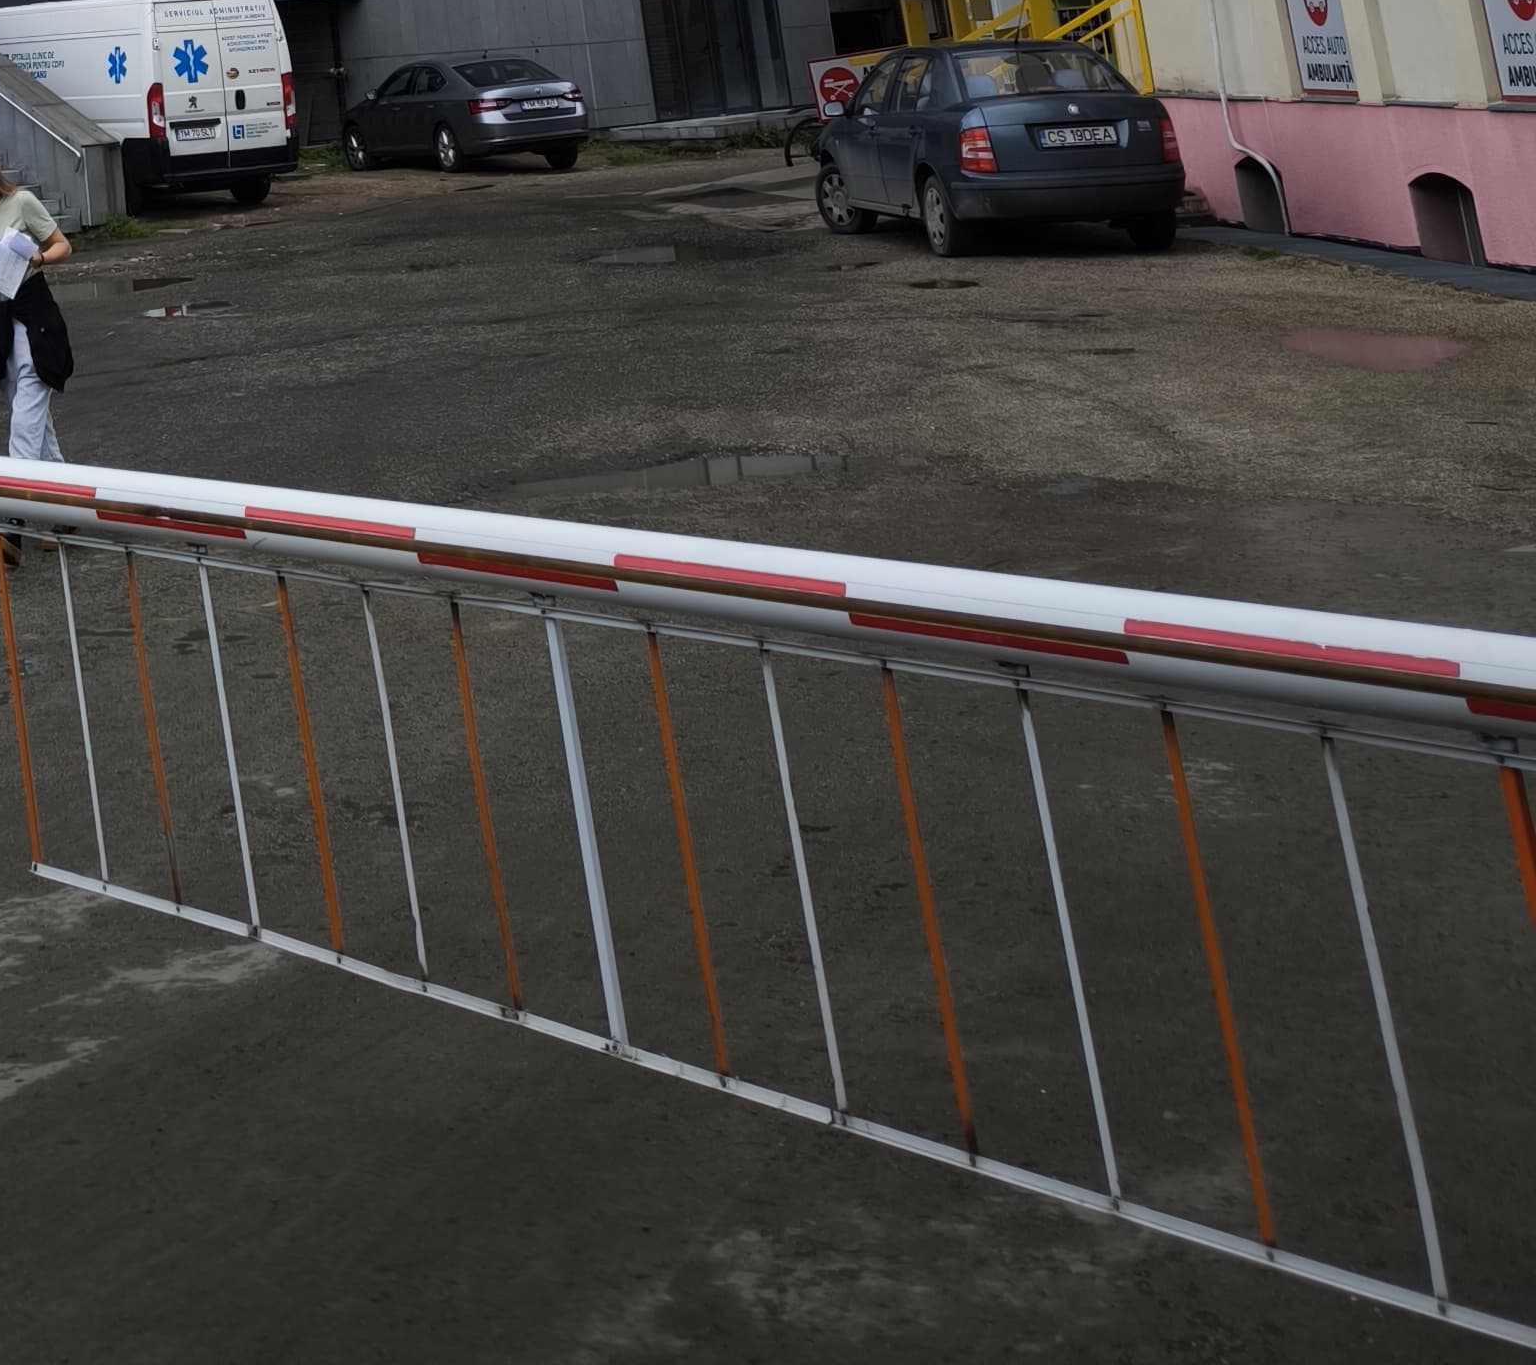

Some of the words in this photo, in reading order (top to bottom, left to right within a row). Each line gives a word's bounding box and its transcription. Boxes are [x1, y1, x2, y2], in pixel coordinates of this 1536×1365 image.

[164, 8, 204, 18] SERVICIUL
[209, 5, 266, 15] ADMINISTRATIV
[1303, 35, 1326, 54] ACCES
[1327, 35, 1347, 55] AUTO
[1503, 32, 1534, 55] ACCES
[1047, 130, 1067, 143] CS
